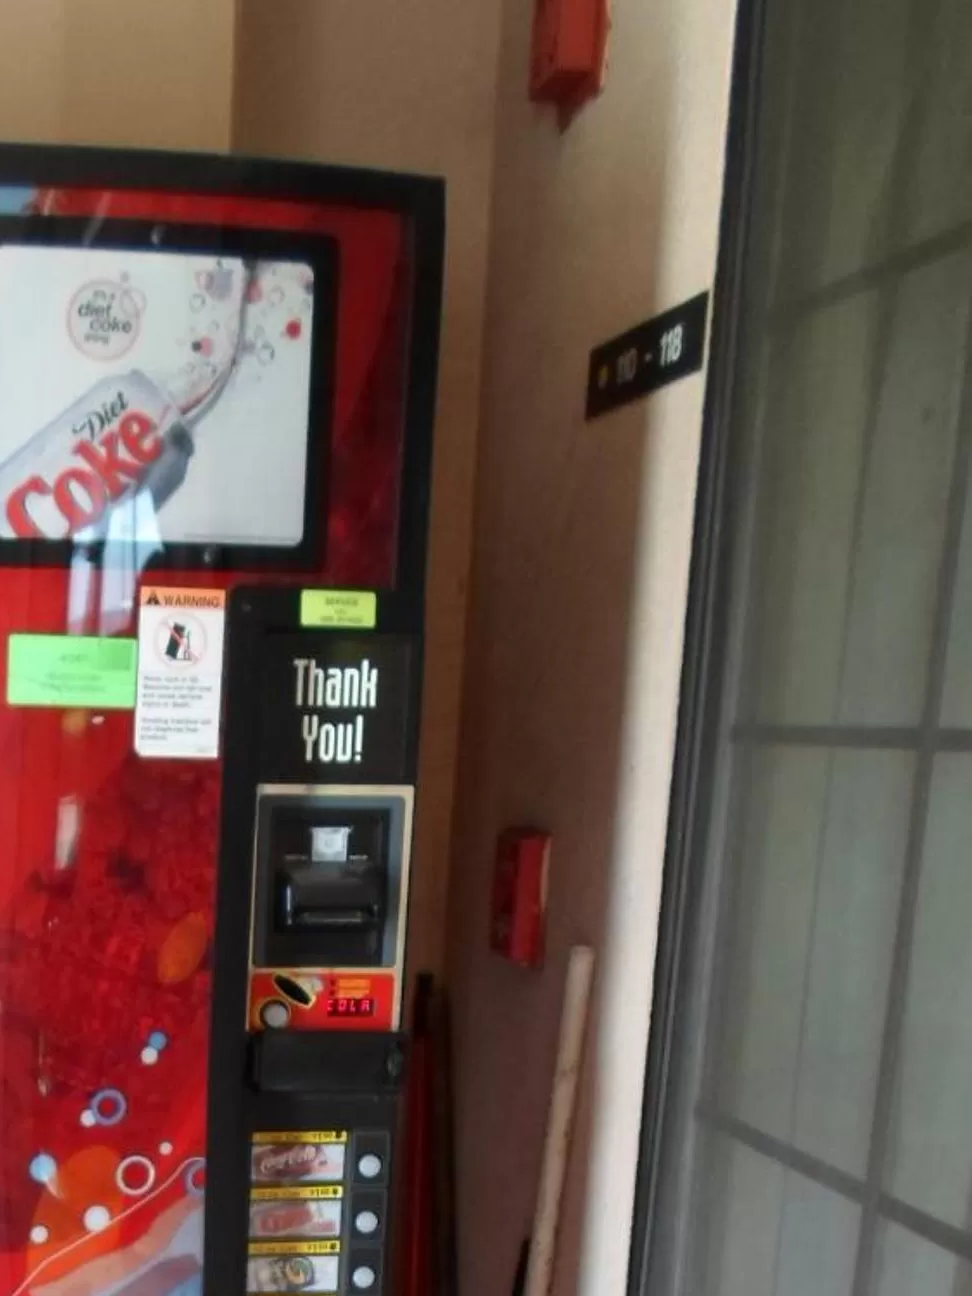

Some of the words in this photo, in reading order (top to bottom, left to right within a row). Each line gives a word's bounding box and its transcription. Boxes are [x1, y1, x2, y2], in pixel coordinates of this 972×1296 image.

[660, 323, 684, 368] 118
[71, 391, 128, 442] Diet
[6, 411, 163, 538] Coke
[163, 594, 221, 609] WARNING
[293, 656, 379, 709] Thank
[301, 714, 364, 764] You!
